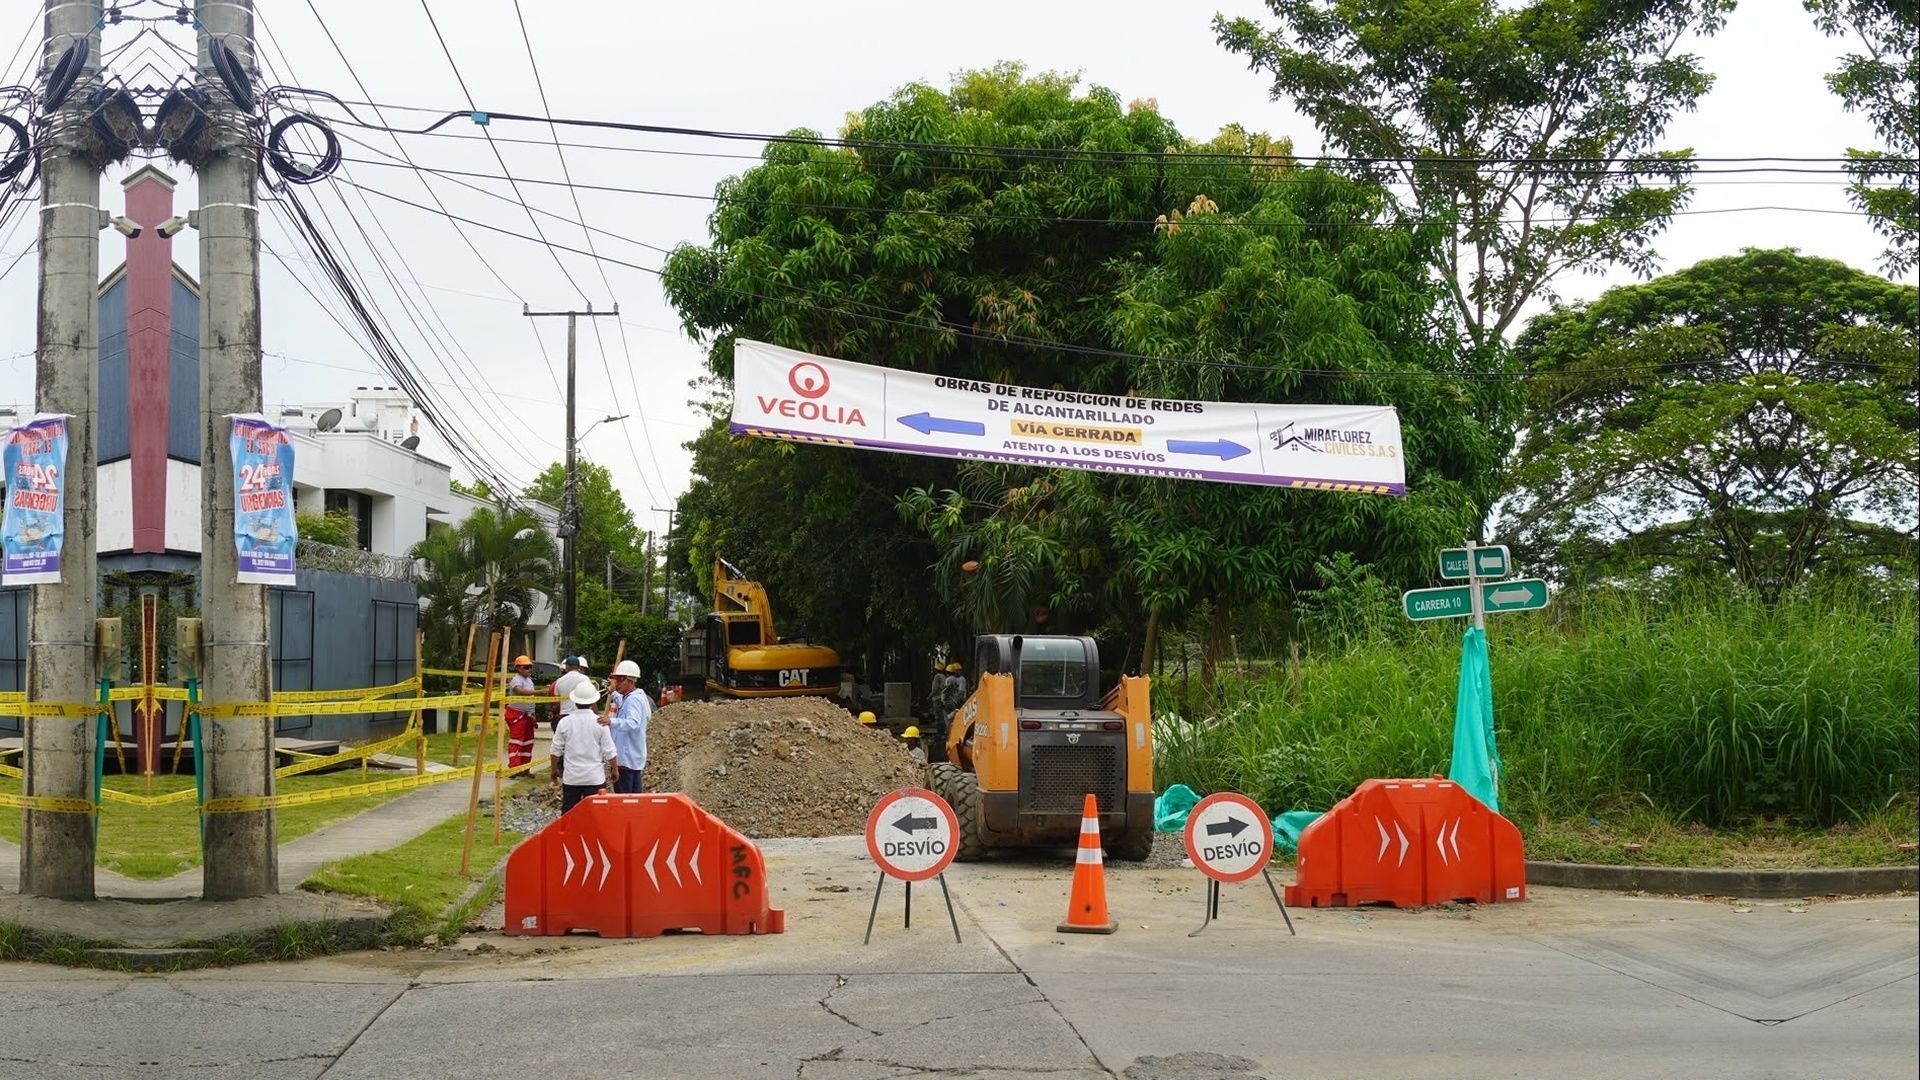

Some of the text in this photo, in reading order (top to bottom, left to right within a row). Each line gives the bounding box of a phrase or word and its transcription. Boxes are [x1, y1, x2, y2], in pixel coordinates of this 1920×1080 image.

[935, 377, 991, 394] OBRAS
[996, 385, 1018, 397] DE
[1126, 398, 1147, 410] DE
[1151, 400, 1204, 414] REDES
[757, 395, 866, 427] VEOLIA
[988, 399, 1155, 425] DE ALCANTARILLADO
[1017, 422, 1137, 443] VÍA CERRADA
[1304, 428, 1373, 444] MIRAFLOREZ
[1002, 440, 1166, 463] ATENTO A LOS DESVÍOS
[1324, 442, 1368, 456] CIVILES
[239, 463, 265, 491] 24
[1446, 560, 1462, 571] CALLE
[1415, 597, 1462, 612] CARRERA 10
[779, 669, 809, 687] CAT
[884, 836, 945, 857] DESVÍO
[1203, 838, 1262, 861] DESVÍO
